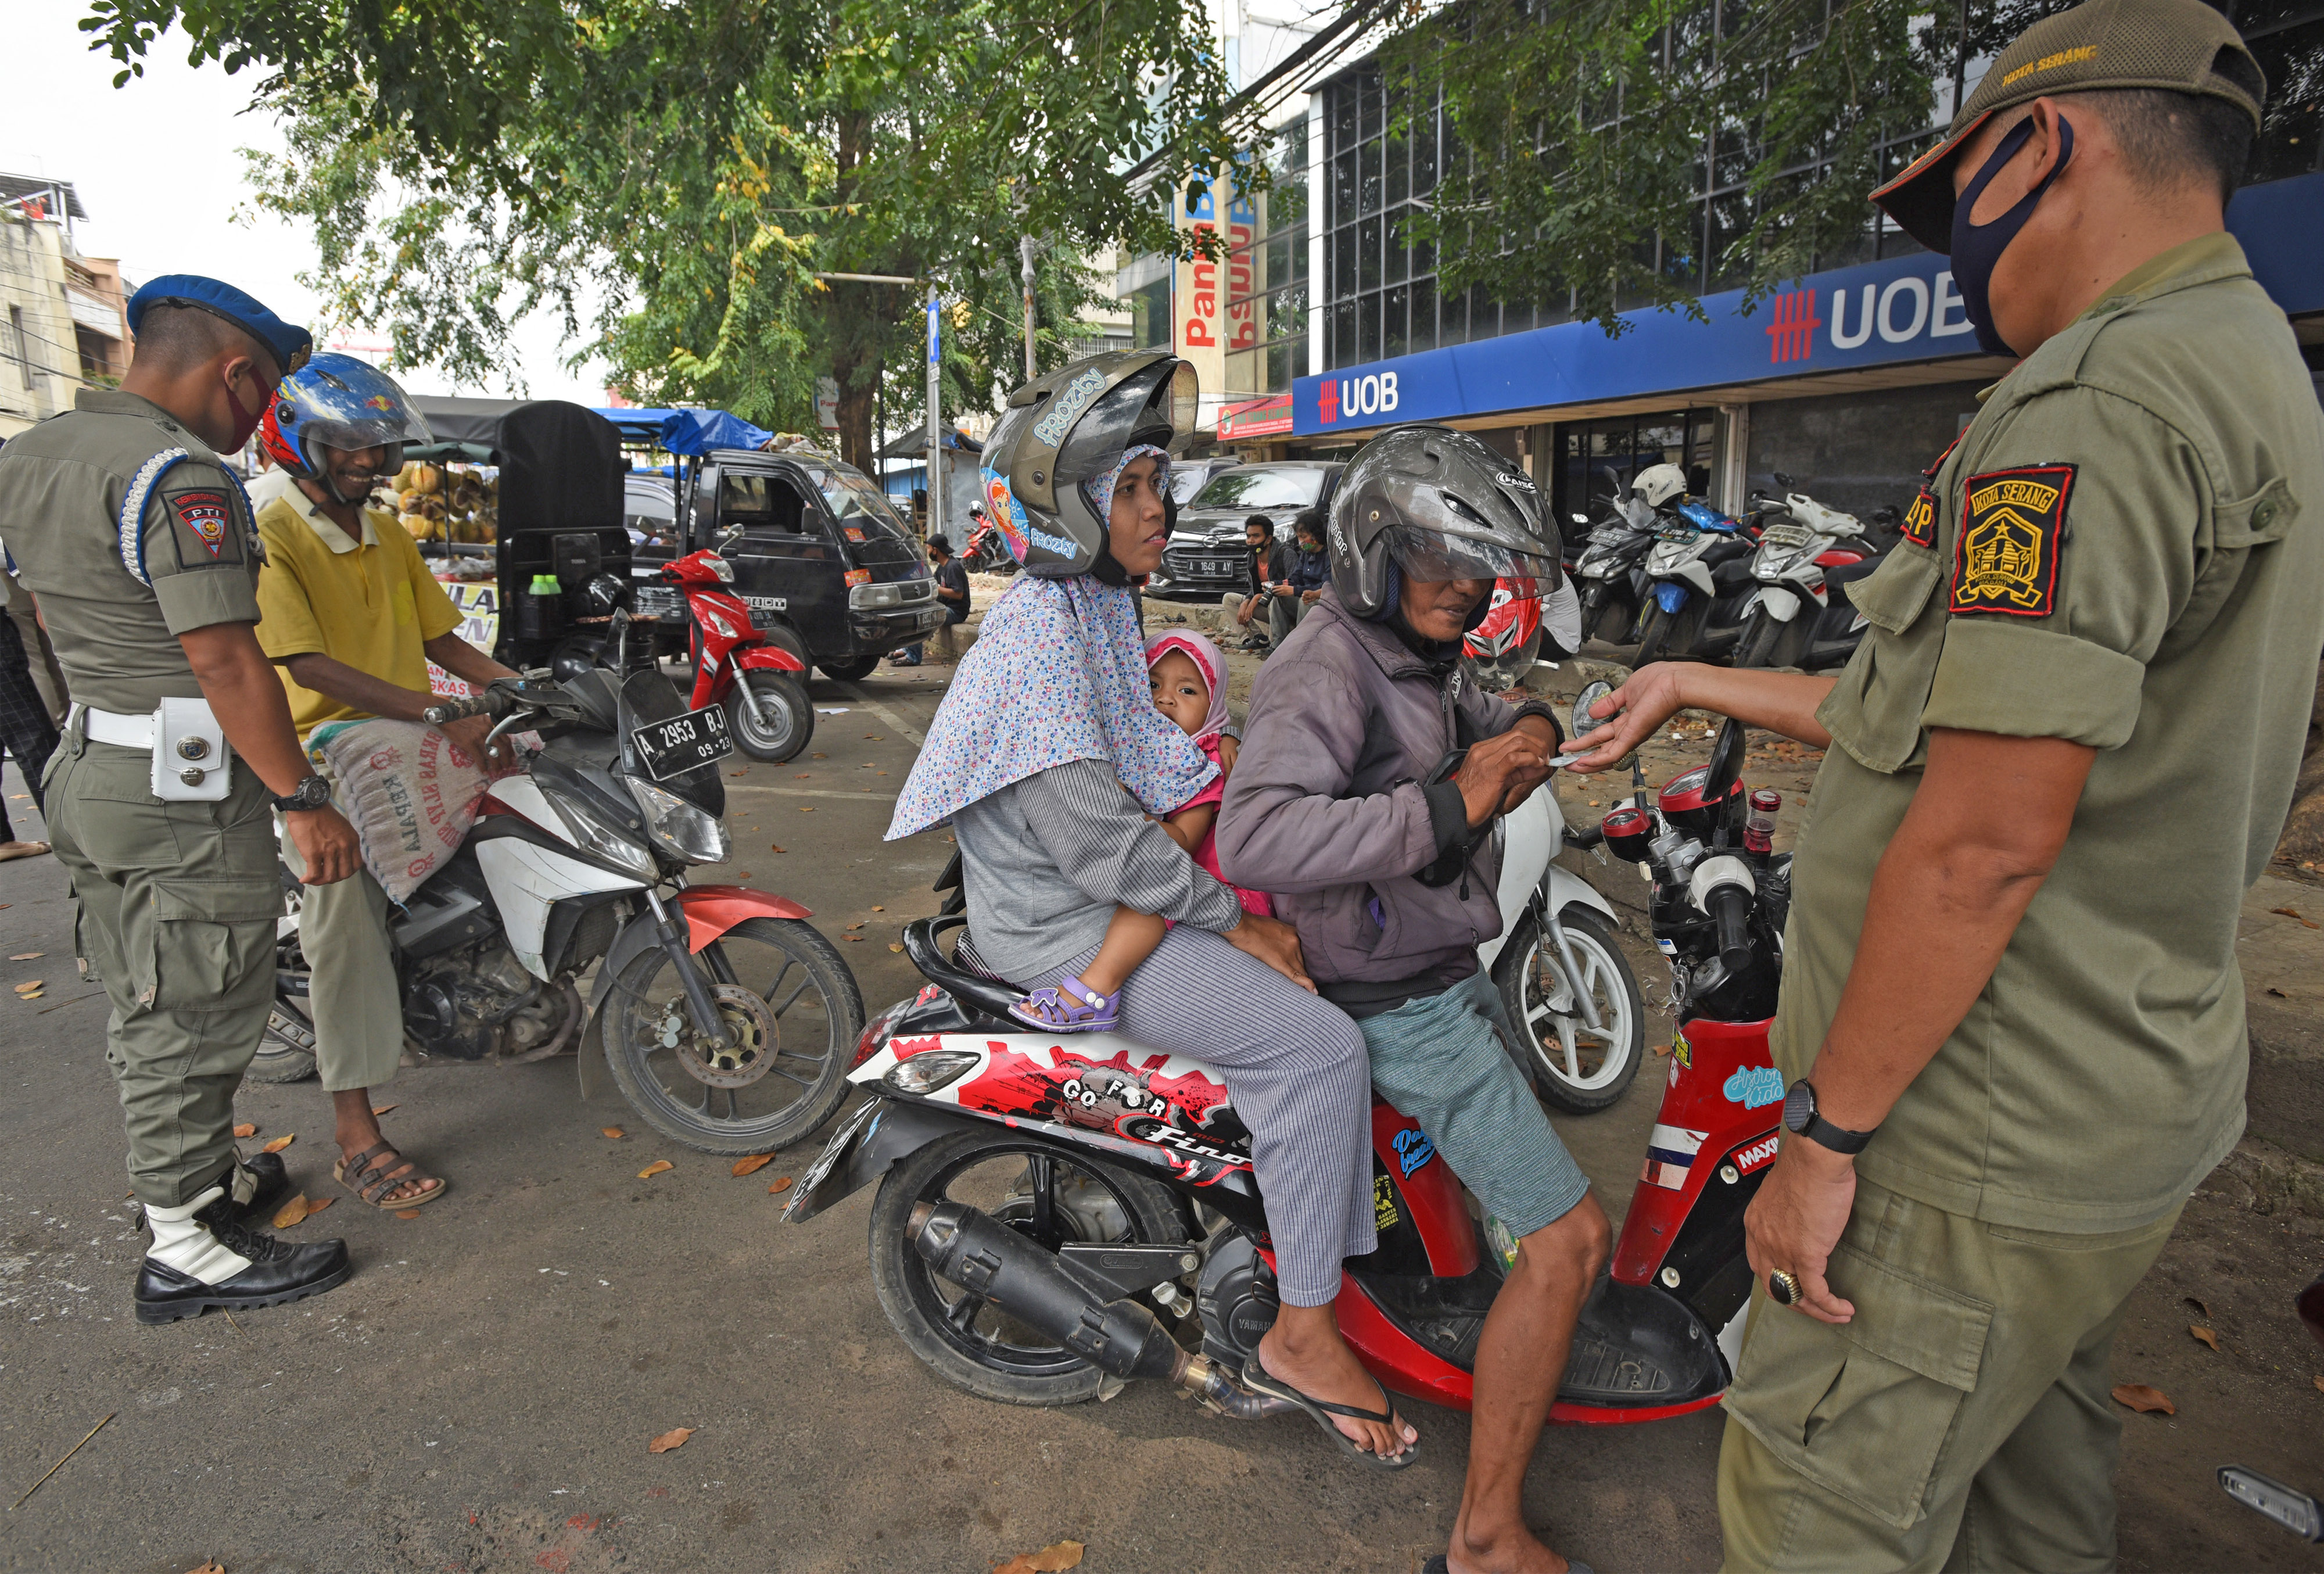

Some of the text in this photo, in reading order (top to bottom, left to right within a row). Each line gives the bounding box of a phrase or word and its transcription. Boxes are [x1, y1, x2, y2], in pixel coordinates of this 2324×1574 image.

[2002, 45, 2097, 87] KOTA SERANG
[1830, 270, 1975, 349] UOB
[929, 309, 937, 356] P
[1343, 371, 1398, 417] UOB
[192, 508, 219, 518] PTI
[1975, 483, 2052, 510] KOTA SERANG
[1189, 562, 1231, 571] A 1649 AY
[639, 709, 724, 755] A 2953 BJ
[1063, 1080, 1165, 1117] GO FOR
[1145, 1125, 1252, 1164] Fino
[1192, 1132, 1225, 1144] mio
[1238, 1318, 1274, 1332] YAMAH
